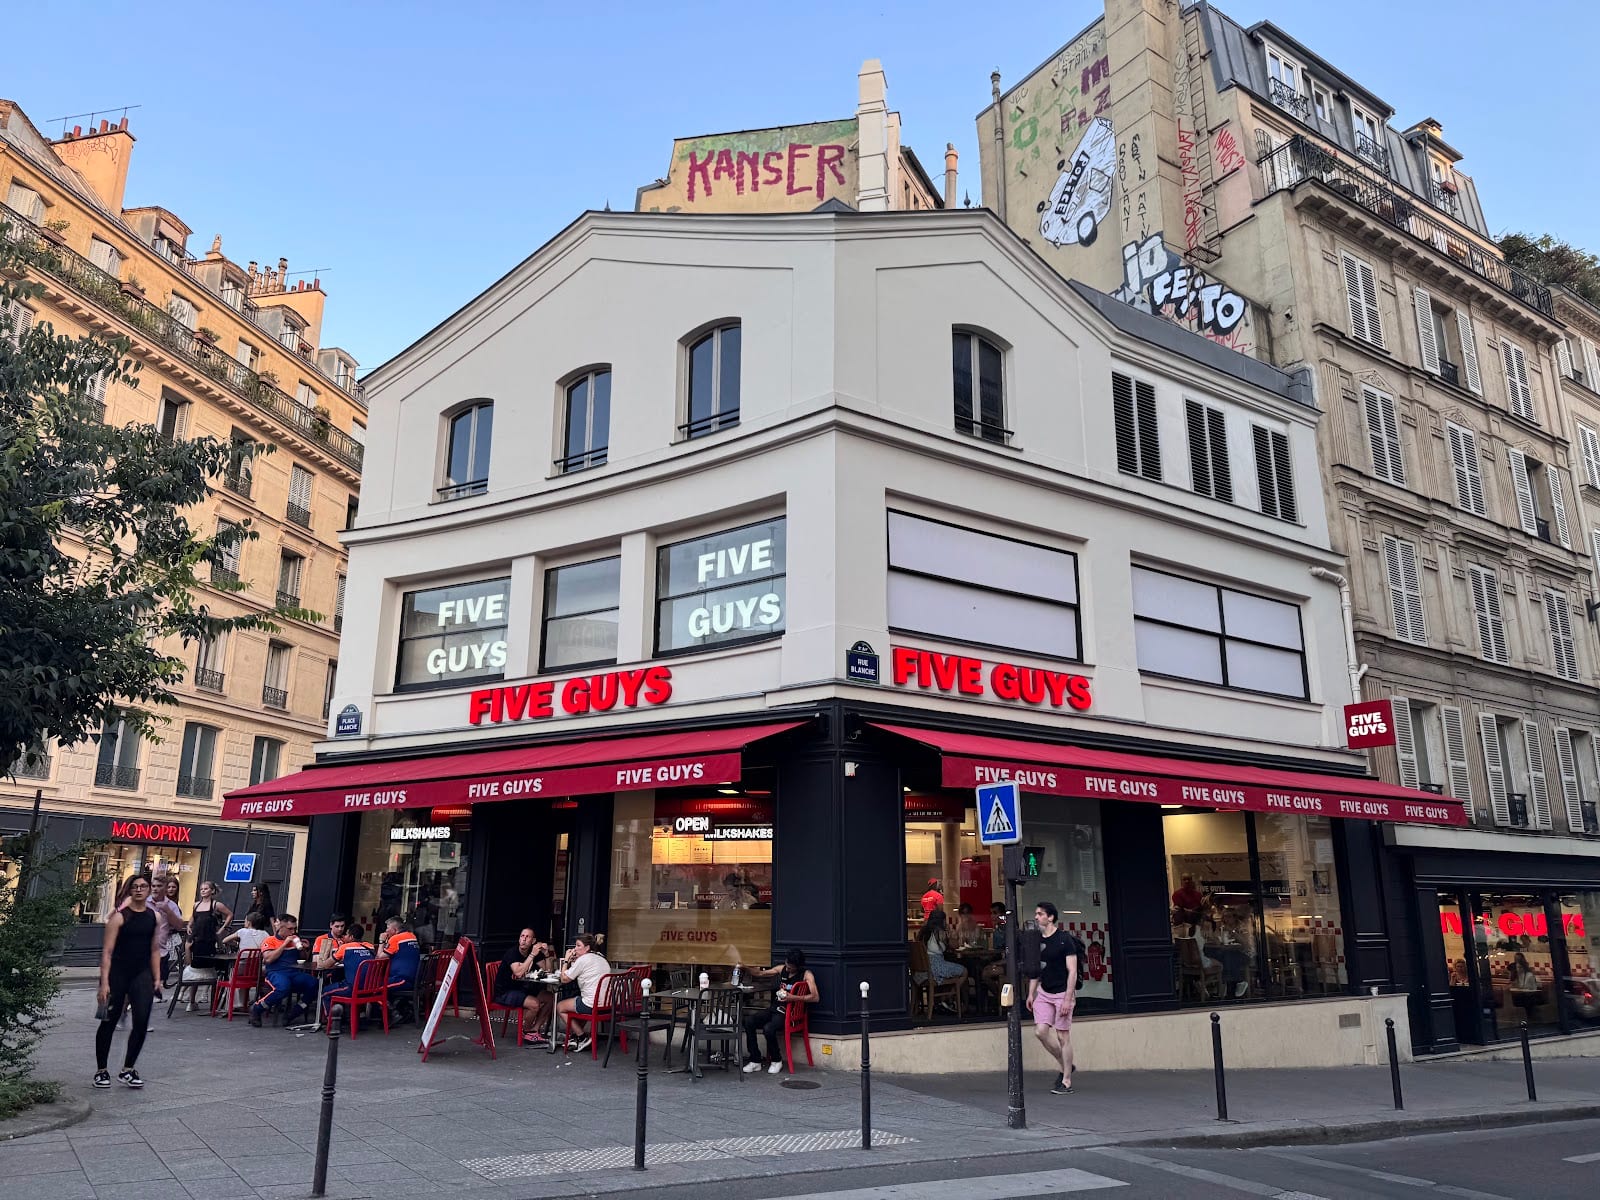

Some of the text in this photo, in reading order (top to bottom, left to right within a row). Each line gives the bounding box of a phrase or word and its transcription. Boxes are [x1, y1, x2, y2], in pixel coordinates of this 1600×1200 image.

[687, 143, 846, 202] KANSER
[698, 539, 771, 583] FIVE
[438, 594, 504, 627] FIVE
[688, 593, 780, 637] GUYS
[427, 640, 508, 675] GUYS
[850, 666, 876, 676] BLANCHE
[893, 648, 1092, 710] FIVE GUYS
[469, 666, 673, 725] FIVE GUYS
[1350, 711, 1382, 726] FIVE
[1348, 723, 1388, 737] GUYS
[616, 763, 704, 785] FIVE GUYS
[975, 766, 1057, 788] FIVE GUYS
[468, 778, 542, 798] FIVE GUYS
[1085, 776, 1157, 797] FIVE GUYS
[1182, 786, 1245, 805] FIVE GUYS
[240, 799, 293, 815] FIVE GUYS
[344, 790, 407, 807] FIVE GUYS
[1266, 794, 1322, 811] FIVE GUYS
[1340, 800, 1389, 815] FIVE GUYS
[1404, 805, 1449, 820] FIVE GUYS
[112, 820, 191, 843] MONOPRIX
[390, 826, 451, 840] MILKSHAKES
[675, 816, 709, 832] OPEN
[229, 862, 252, 873] TAXIS
[660, 930, 718, 942] FIVE GUYS
